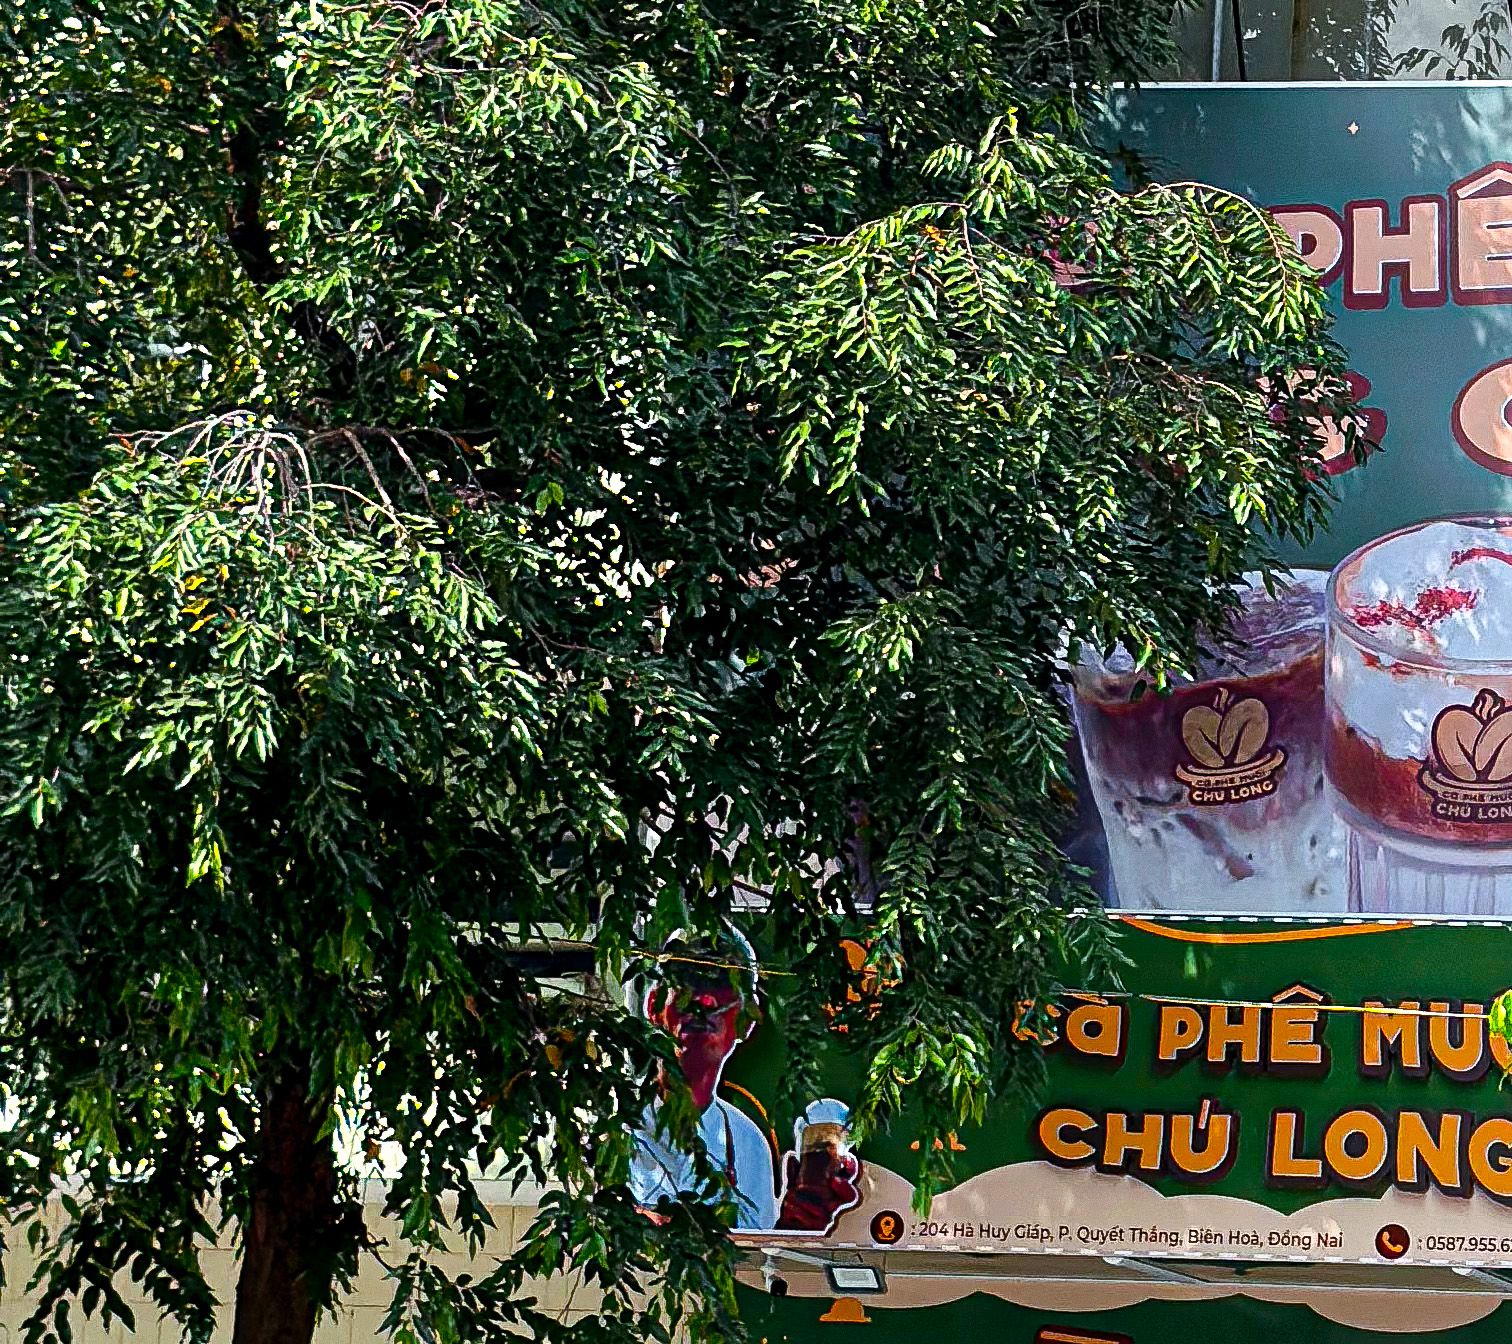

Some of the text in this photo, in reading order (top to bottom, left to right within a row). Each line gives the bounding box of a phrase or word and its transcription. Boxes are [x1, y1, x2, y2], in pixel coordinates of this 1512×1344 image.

[1231, 780, 1273, 800] LONG
[1158, 984, 1323, 1063] PHÊ
[1038, 1098, 1232, 1173] CHÚ
[918, 1223, 1344, 1249] 204 Hà Huy Giáp, P. Quyết Thắng, Biên Hoà, Đồng Nai
